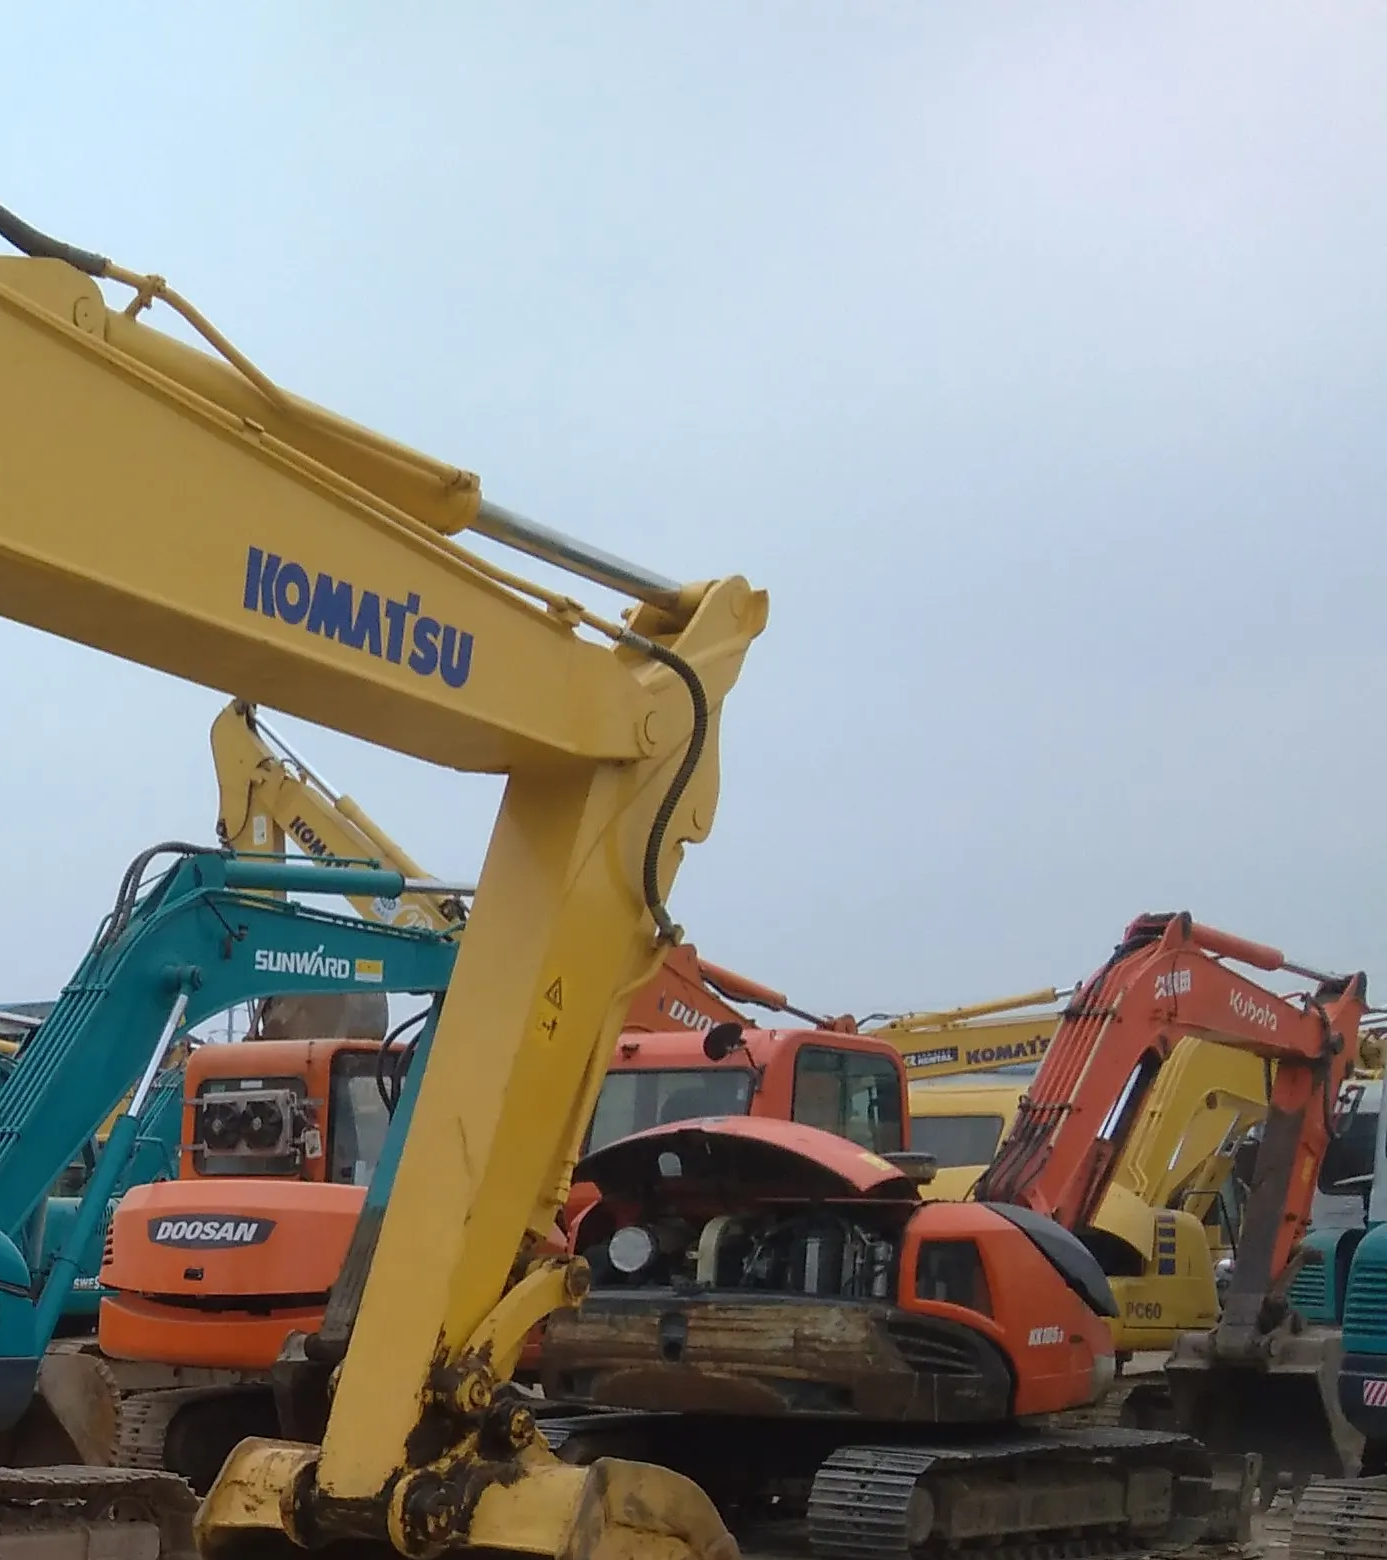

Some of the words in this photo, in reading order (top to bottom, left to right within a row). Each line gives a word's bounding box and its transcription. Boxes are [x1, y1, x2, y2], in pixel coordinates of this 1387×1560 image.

[243, 545, 474, 688] KOMATSU
[254, 944, 351, 979] SUNWARD
[668, 999, 720, 1032] DOO
[1229, 987, 1278, 1031] Kubota
[155, 1221, 259, 1242] DOOSAN
